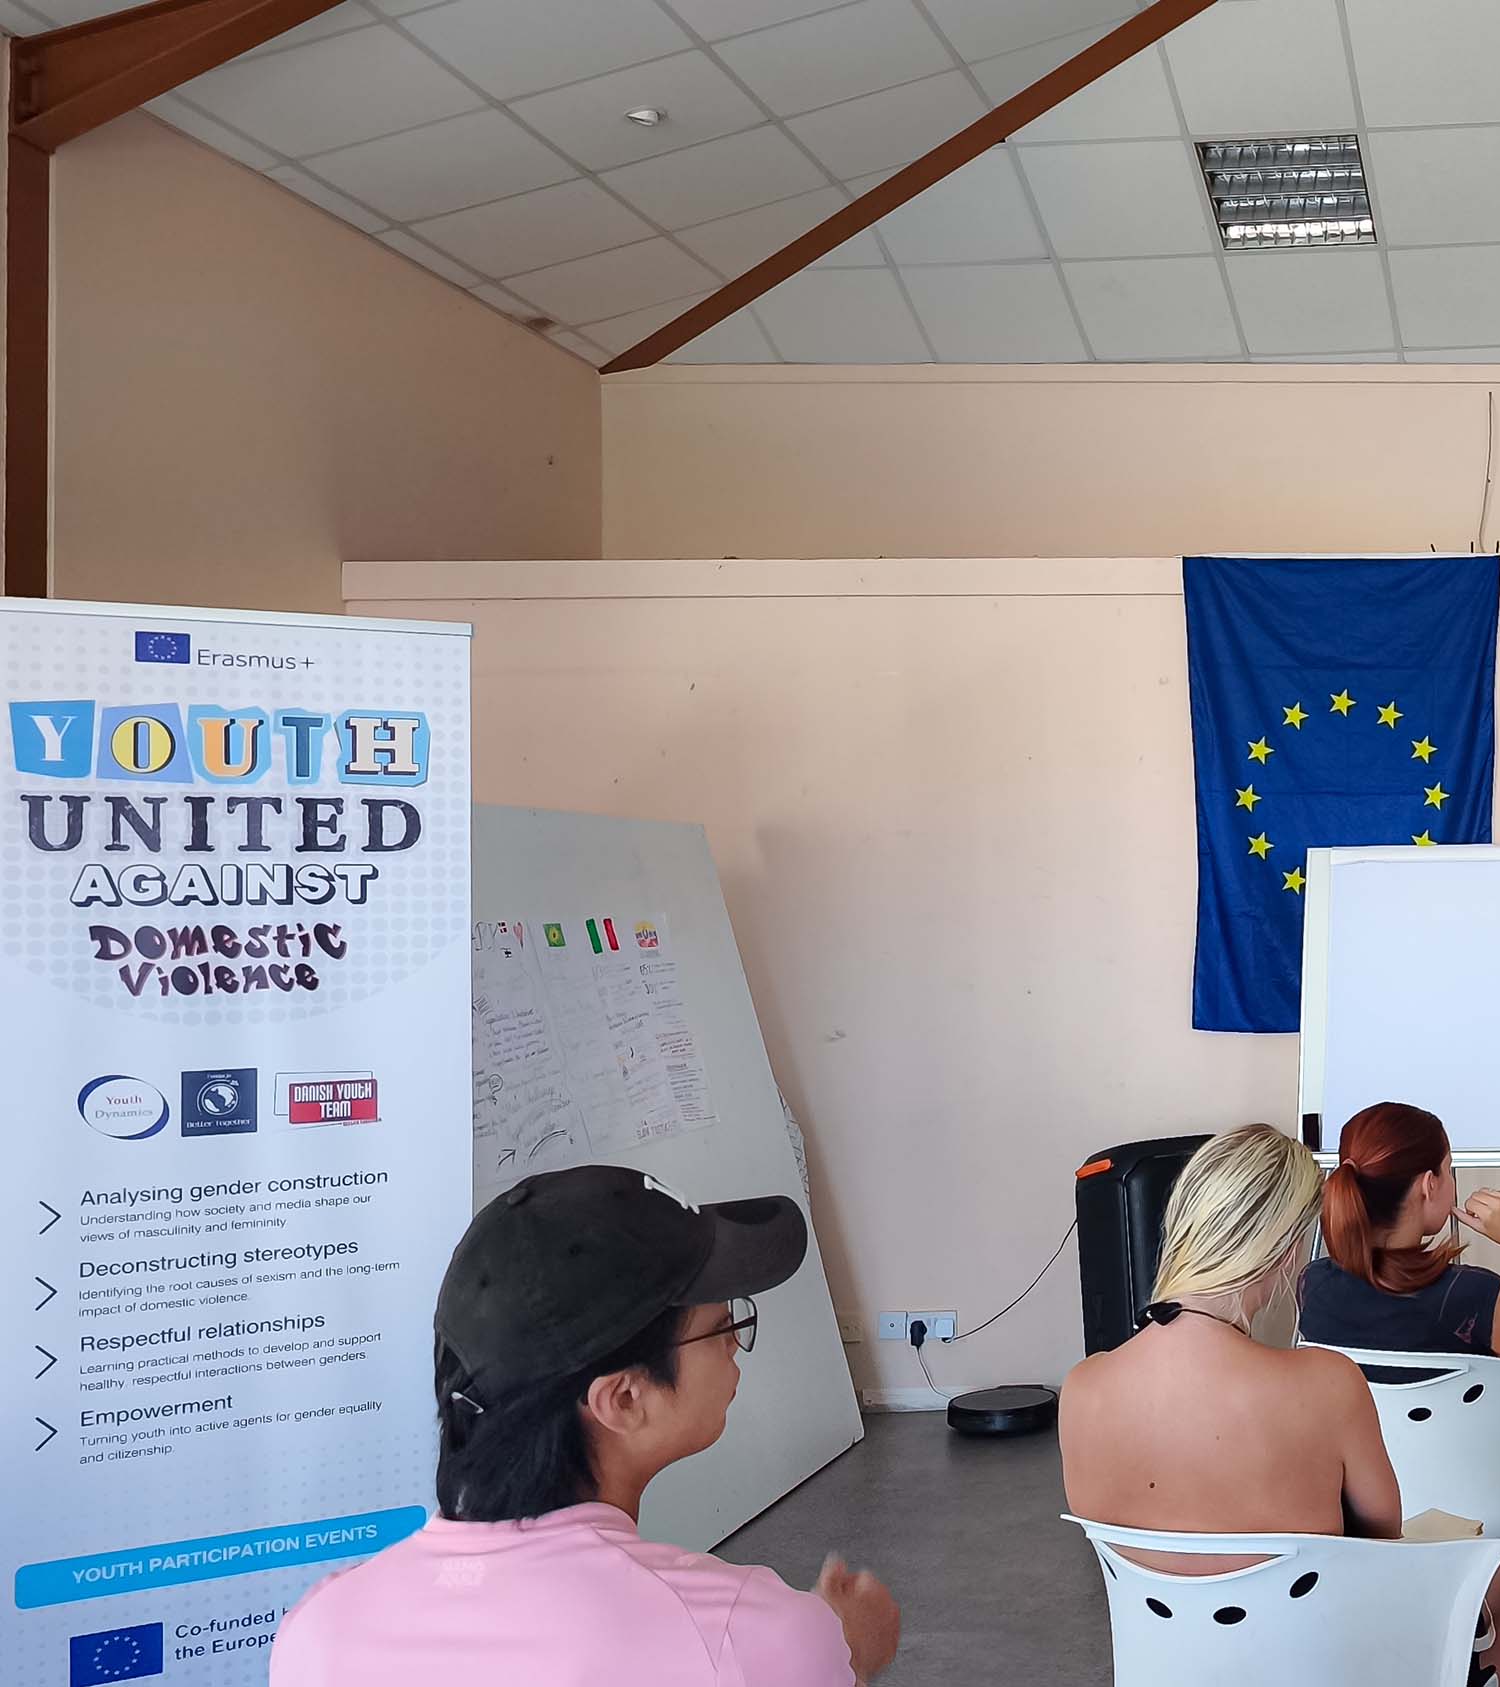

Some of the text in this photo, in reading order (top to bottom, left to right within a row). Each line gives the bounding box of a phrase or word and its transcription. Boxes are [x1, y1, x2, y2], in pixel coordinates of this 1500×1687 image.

[197, 649, 315, 671] Erasmus+
[29, 715, 421, 777] YOUTH
[20, 794, 422, 853] UNITED
[70, 864, 380, 908] AGAINST
[106, 1096, 143, 1105] Youth
[294, 1084, 333, 1102] DANISH
[95, 1109, 153, 1119] Dynamics
[319, 1101, 351, 1118] TEAM
[80, 1170, 388, 1207] Analysing gender construction
[80, 1195, 371, 1226] Understanding how society and media shape our
[79, 1232, 115, 1242] views
[118, 1229, 130, 1239] of
[133, 1223, 201, 1238] masculinity
[204, 1221, 228, 1232] and
[79, 1241, 358, 1278] Deconstructing stereotypes
[78, 1261, 400, 1300] Identifying the root causes of sexism and the long-term
[78, 1304, 121, 1318] impact
[124, 1302, 136, 1313] of
[139, 1298, 195, 1311] domestic
[80, 1314, 325, 1352] Respectful relationships
[79, 1332, 381, 1375] Learning practical methods to develop and support
[132, 1369, 191, 1386] respectful
[194, 1363, 263, 1378] interactions
[266, 1357, 316, 1370] between
[79, 1400, 382, 1446] Turning youth into active agents for gender equality
[80, 1395, 232, 1426] Empowerment
[79, 1451, 104, 1465] and
[72, 1524, 377, 1583] YOUTH PARTICIPATION EVENTS
[175, 1609, 275, 1638] Co-funded
[175, 1632, 277, 1660] the Europe
